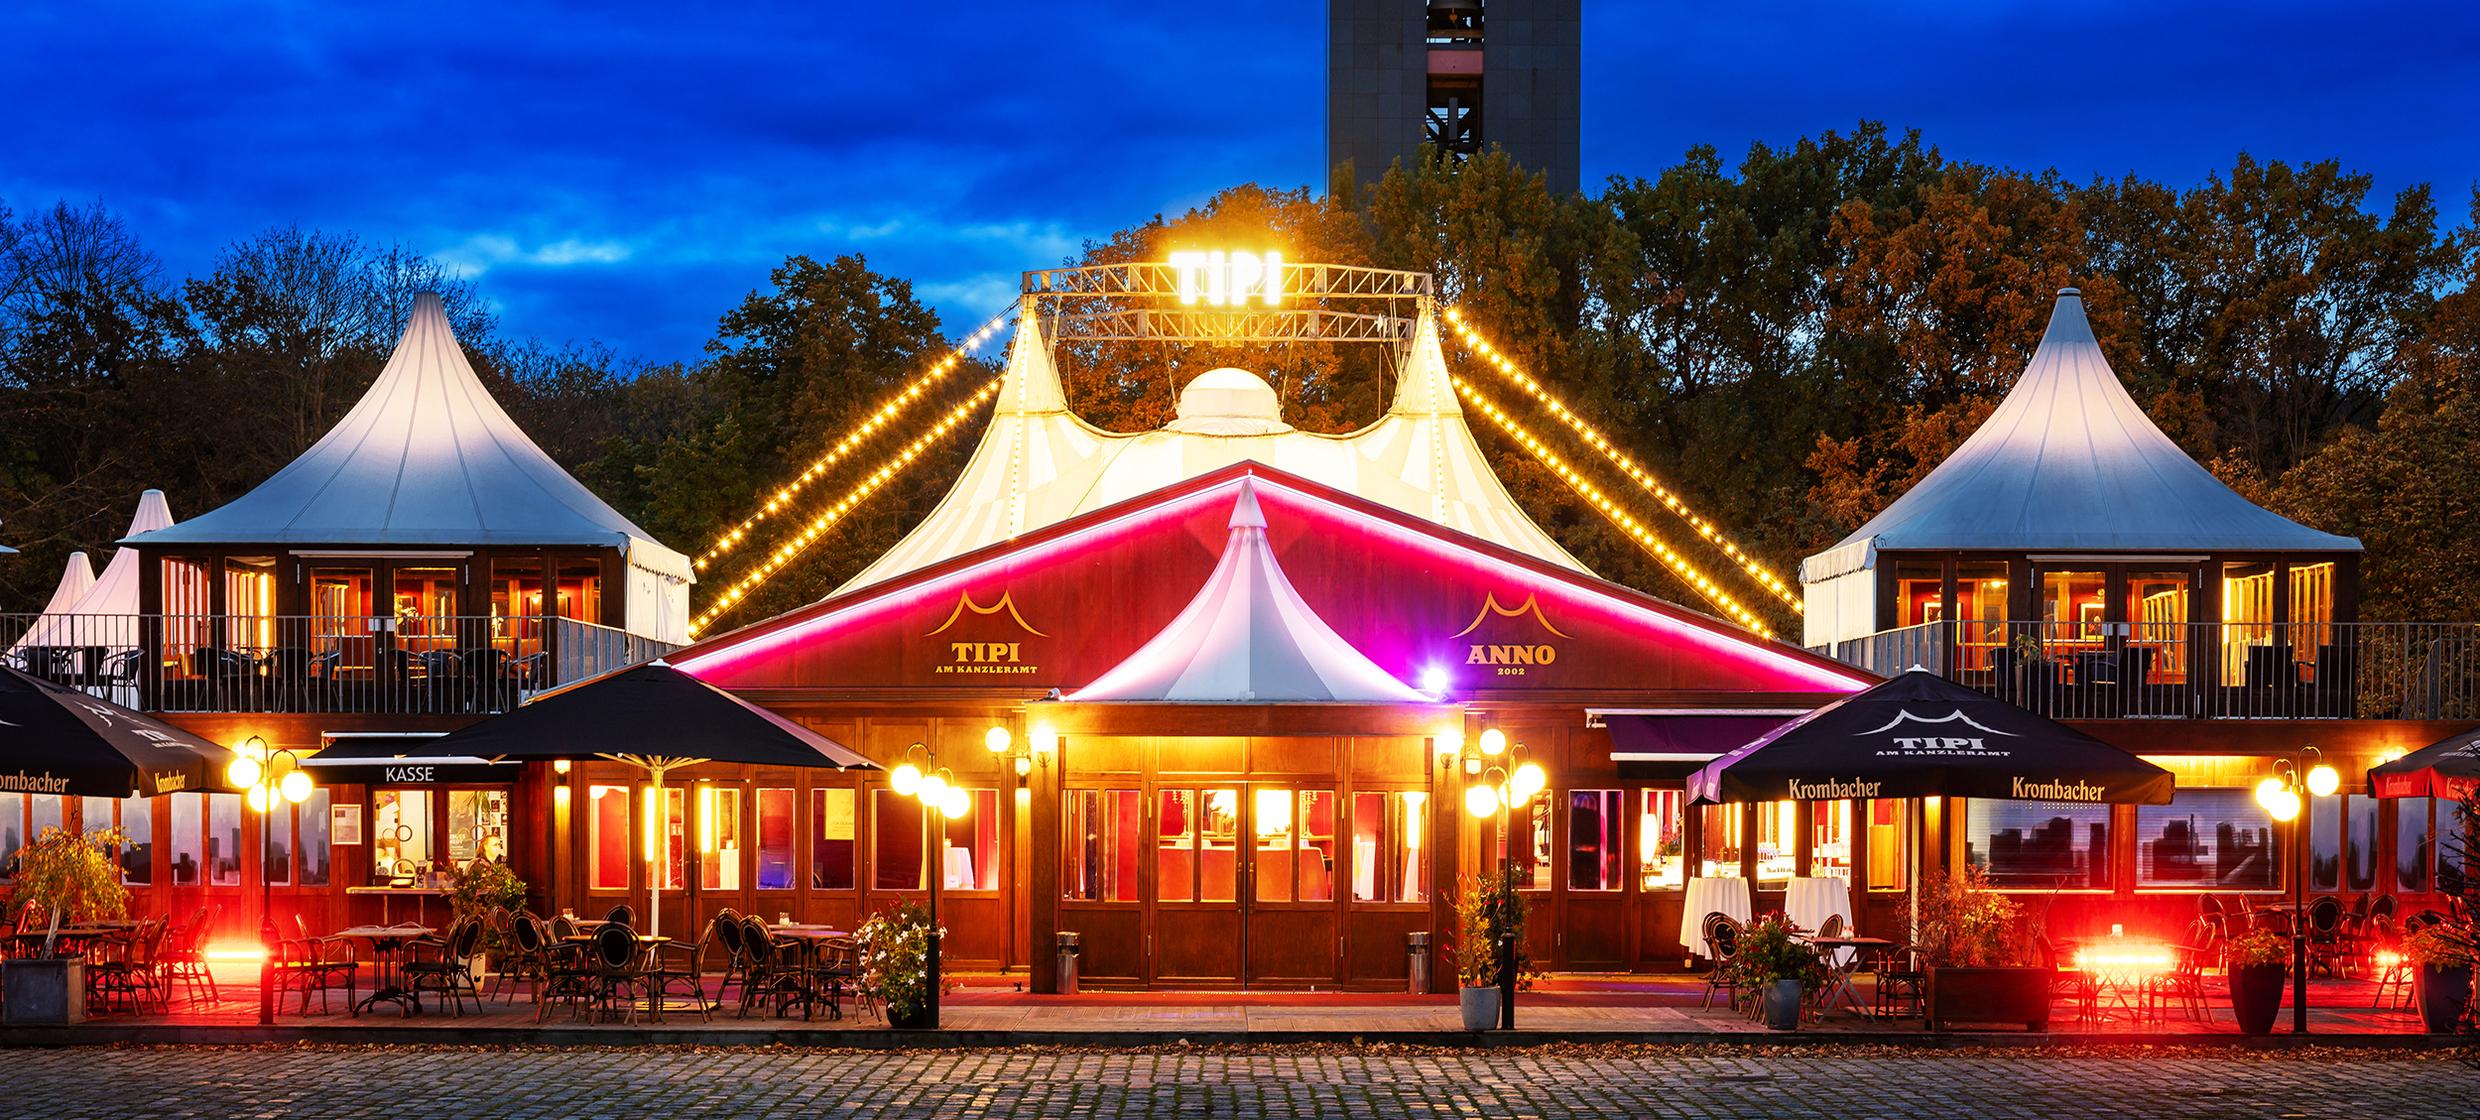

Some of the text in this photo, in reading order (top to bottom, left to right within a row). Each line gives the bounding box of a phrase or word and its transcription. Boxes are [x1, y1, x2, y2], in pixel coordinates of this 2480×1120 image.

[1168, 251, 1282, 305] TIPI
[951, 642, 1021, 662] TIPI
[1465, 645, 1556, 665] ANNO
[957, 665, 1038, 674] KANZLERAMT
[1497, 668, 1525, 676] 2002
[1893, 737, 1987, 750] TIPI
[0, 769, 70, 793] ombacher
[386, 766, 435, 782] KASSE
[1788, 776, 1881, 800] Krombacher
[2012, 776, 2105, 801] Krombacher
